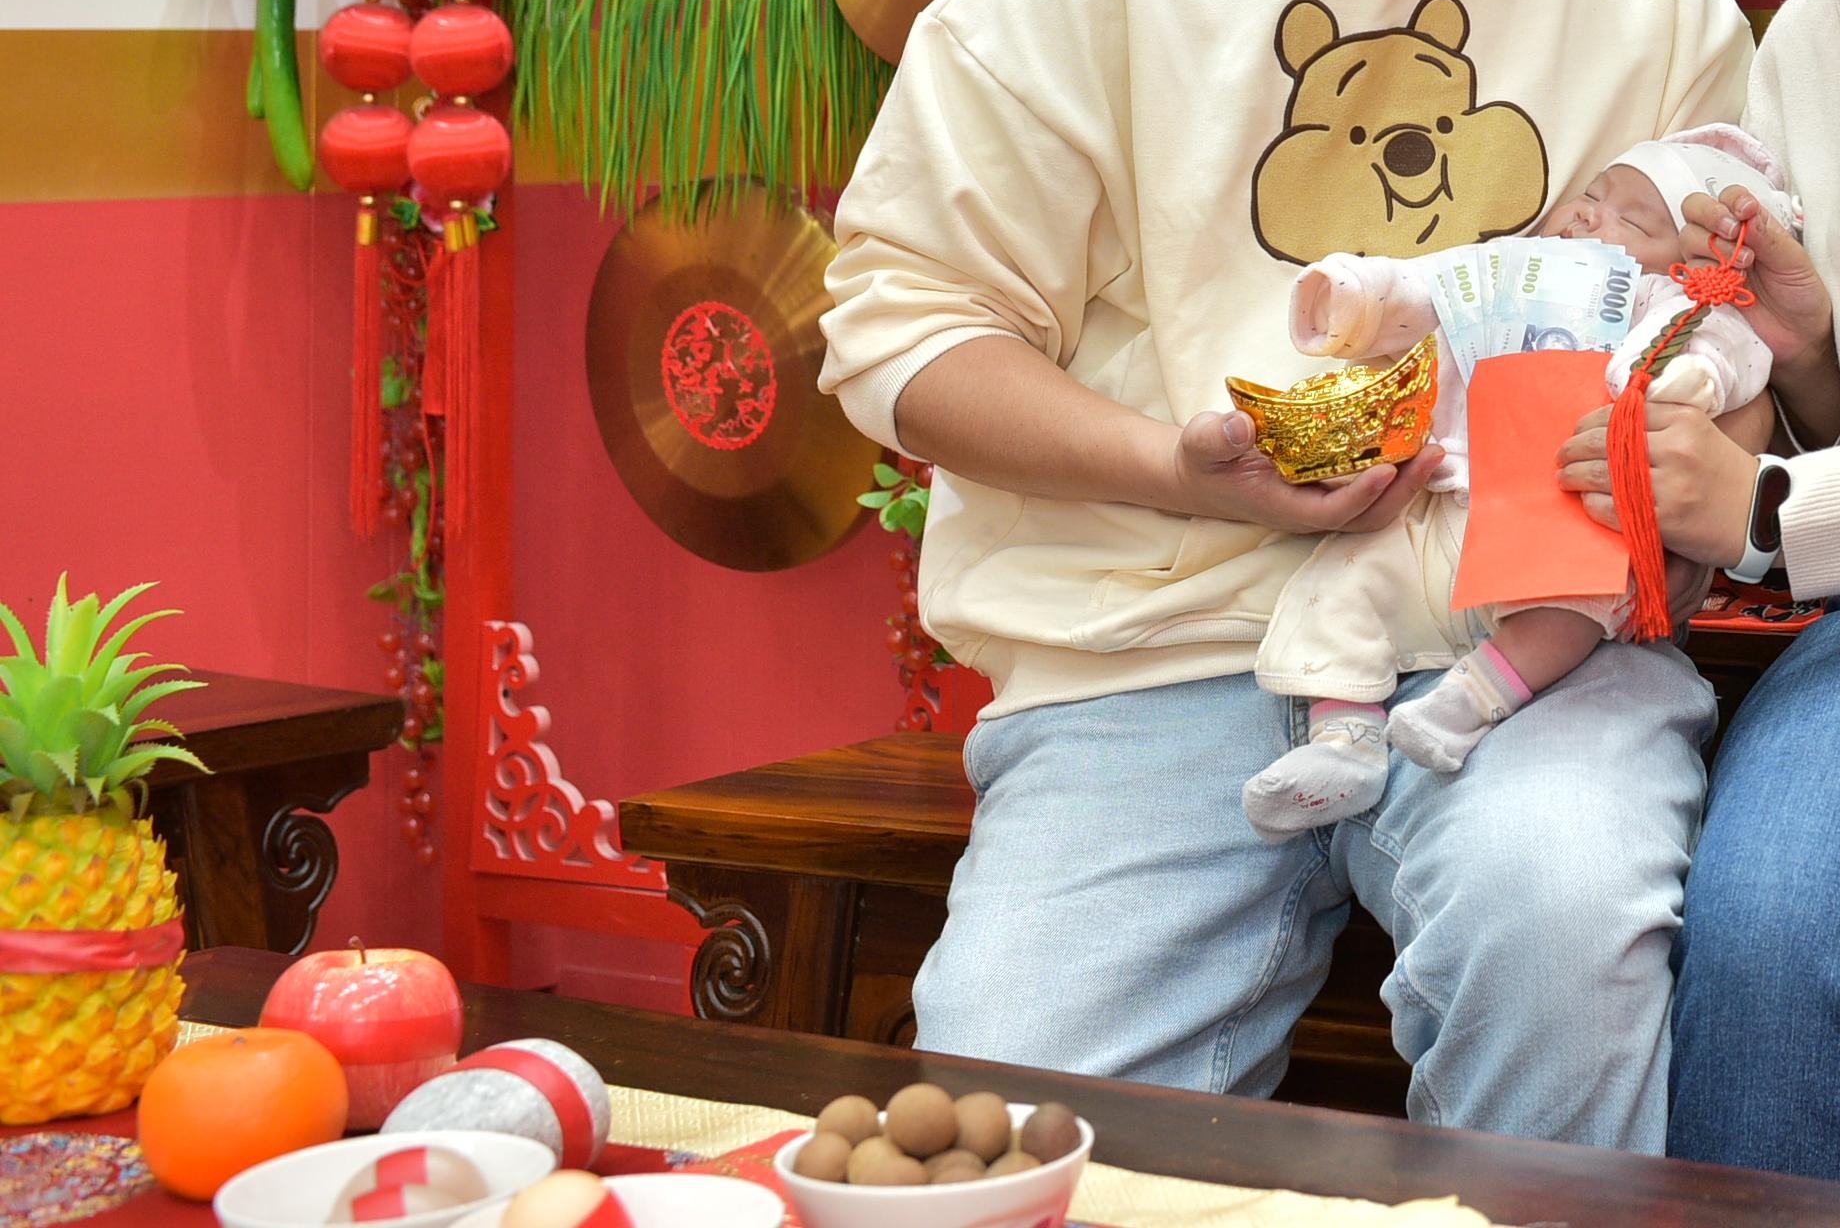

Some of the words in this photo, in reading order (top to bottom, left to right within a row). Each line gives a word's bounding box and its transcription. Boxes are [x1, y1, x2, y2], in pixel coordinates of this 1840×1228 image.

[1453, 263, 1475, 303] 1000
[1522, 256, 1542, 294] 1000
[1600, 266, 1632, 324] 1000
